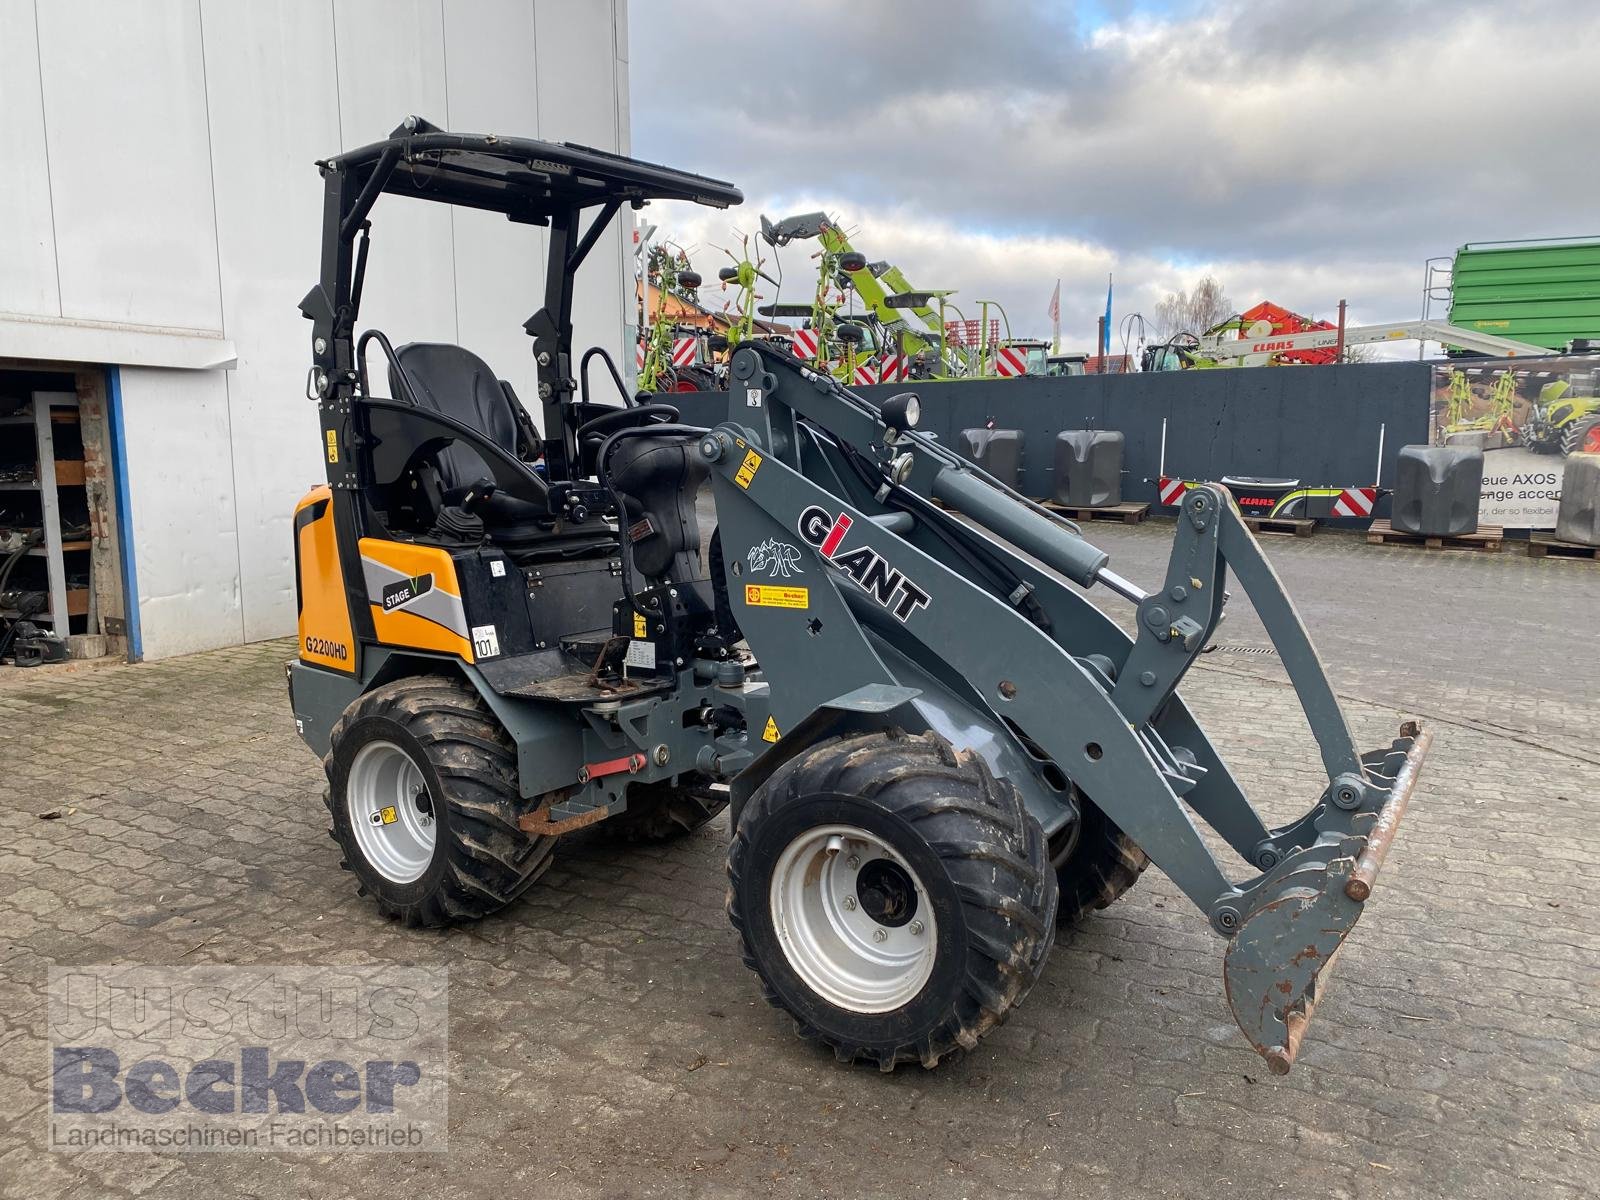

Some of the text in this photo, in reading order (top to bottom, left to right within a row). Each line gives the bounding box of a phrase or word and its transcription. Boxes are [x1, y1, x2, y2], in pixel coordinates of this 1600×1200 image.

[1252, 340, 1294, 353] CLAAS
[1512, 473, 1556, 485] AXOS
[1239, 497, 1275, 507] CLAAS
[386, 588, 410, 607] STAGE
[305, 636, 348, 661] G2200HD
[475, 639, 493, 657] 101
